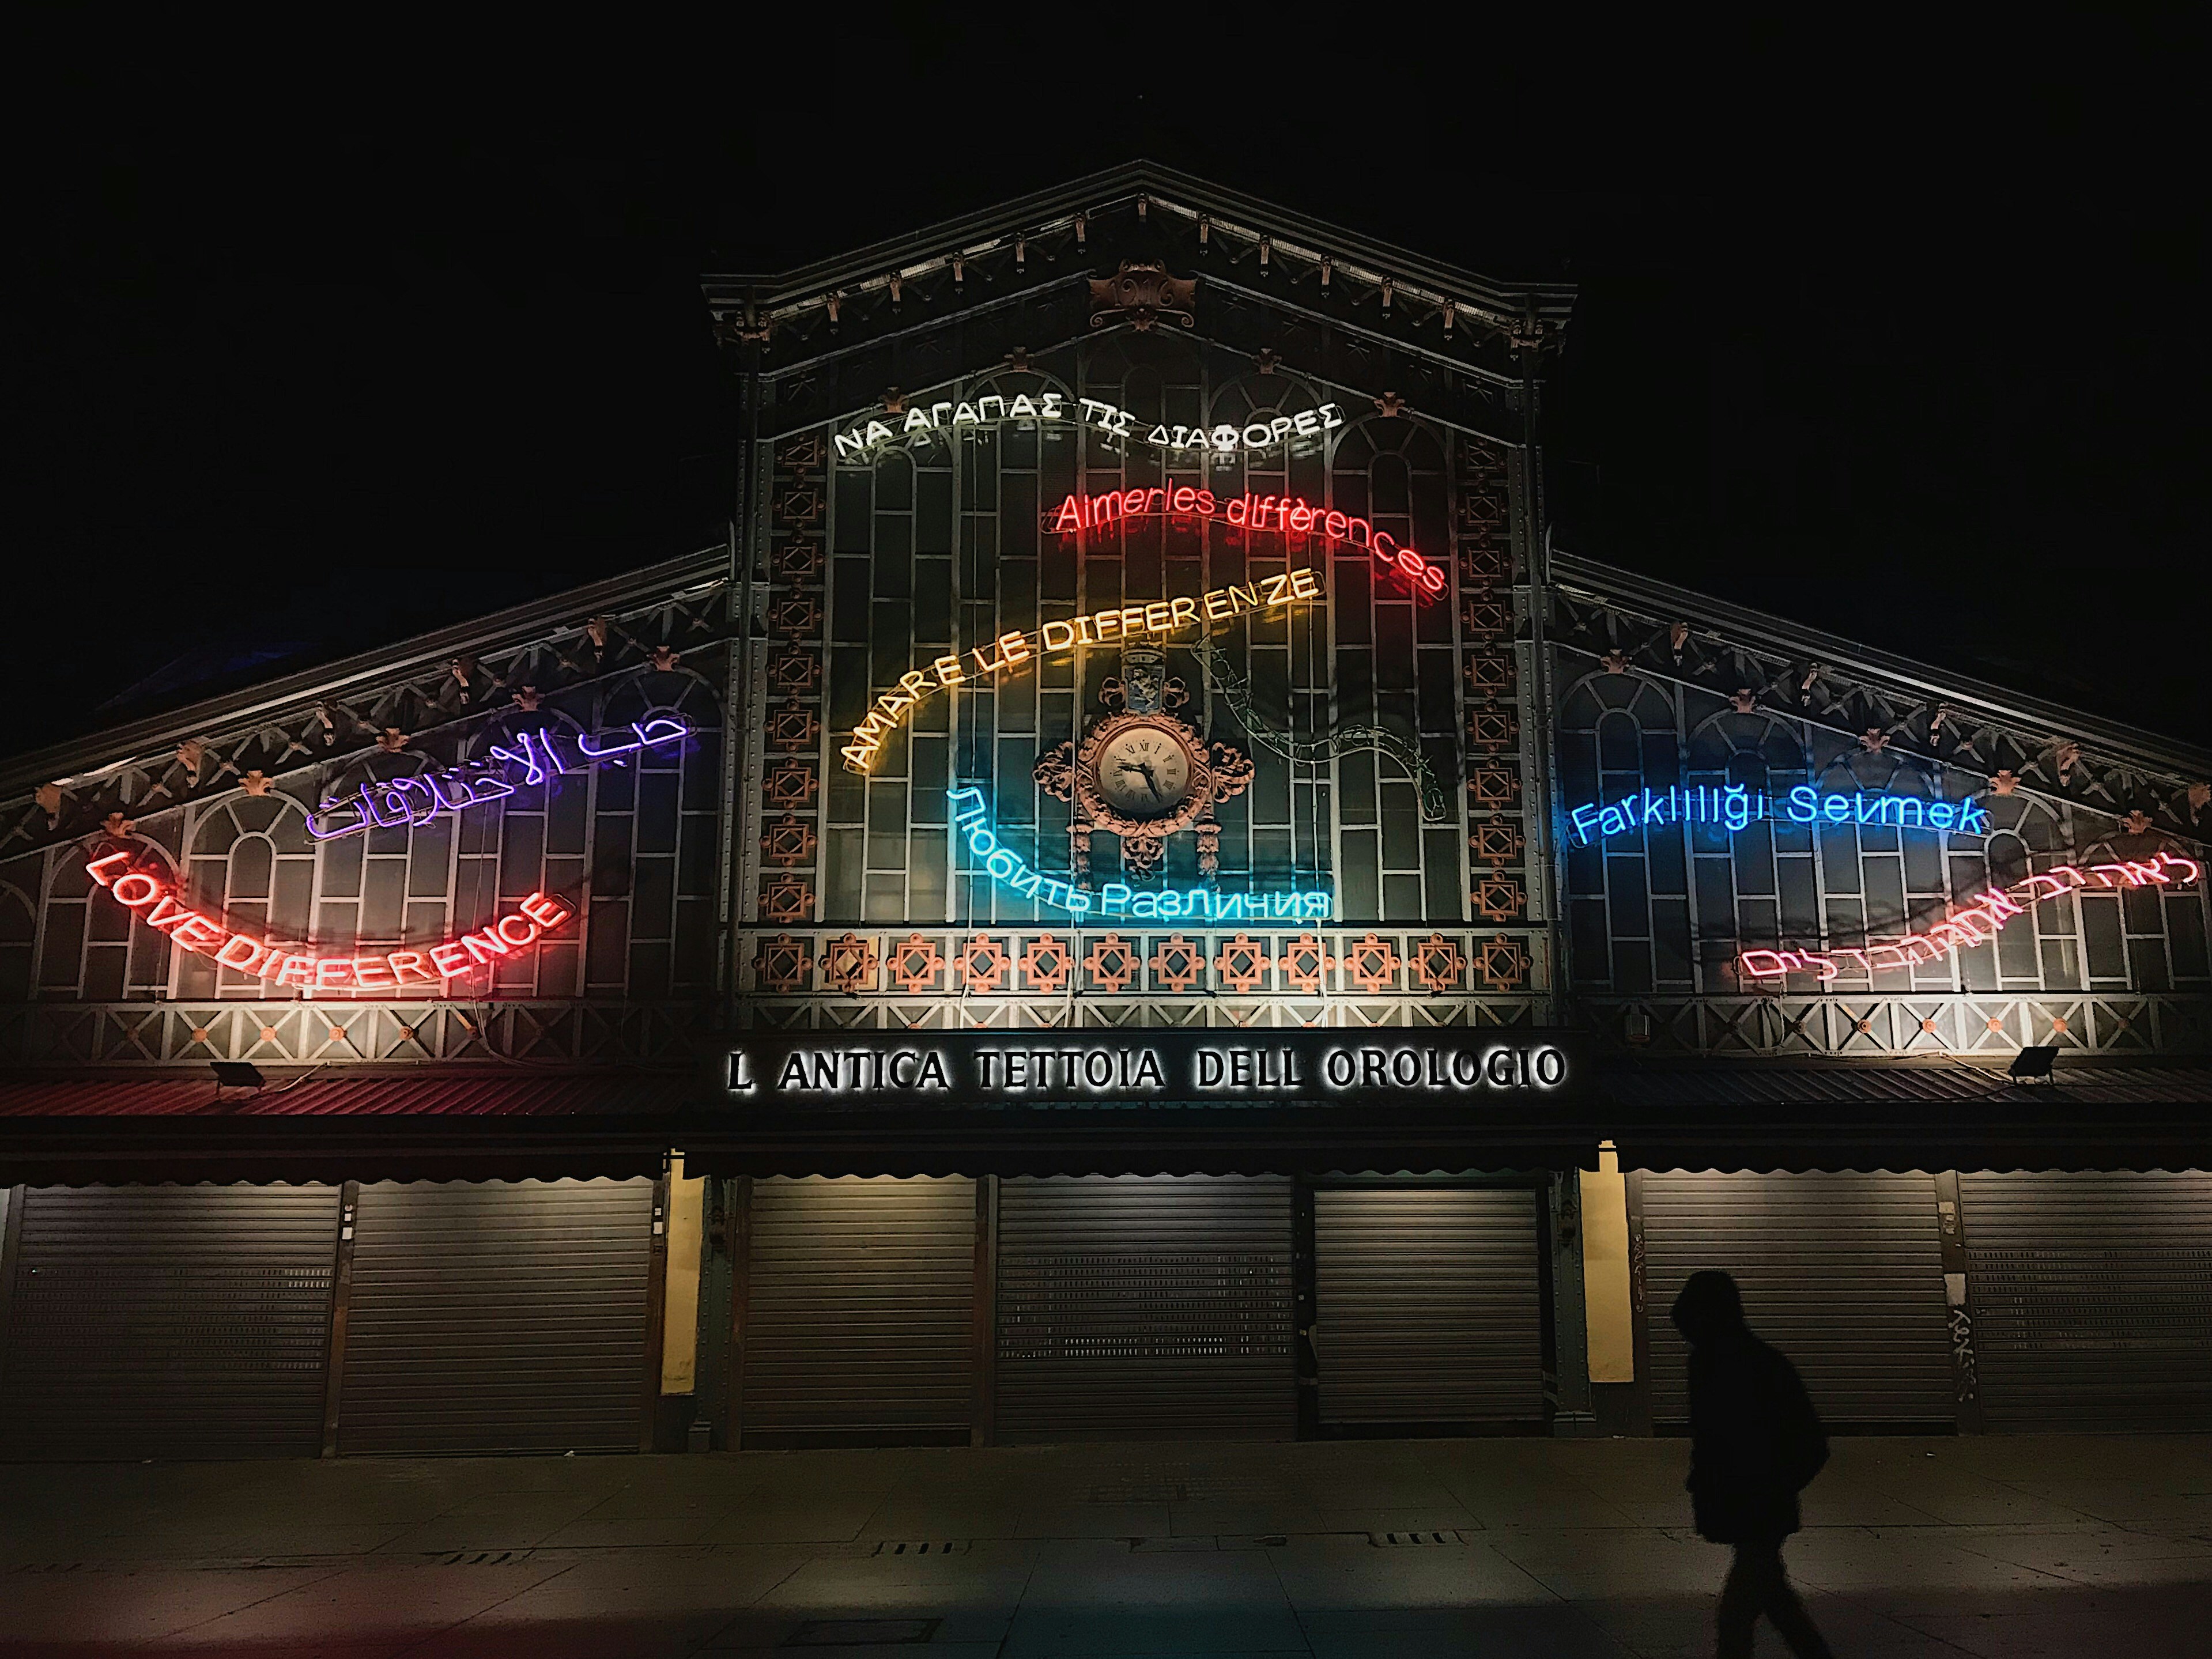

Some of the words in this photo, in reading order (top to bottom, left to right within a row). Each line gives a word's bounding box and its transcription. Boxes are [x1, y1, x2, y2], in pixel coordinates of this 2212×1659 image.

[835, 421, 892, 456] ΝΑ
[904, 394, 1062, 432] ΑΓΑΠΑΣ
[1079, 398, 1135, 437] ΤΙΣ
[1147, 403, 1342, 451] ΔΙΑΦΟΡΕΣ
[841, 655, 965, 769] AMARE
[972, 631, 1029, 672] LE
[1042, 568, 1318, 650] DIFFERENZE
[578, 719, 688, 767] حب
[1787, 786, 1985, 835] Sevmek
[946, 788, 1091, 912] Любить
[1101, 883, 1330, 919] Различия
[2020, 852, 2198, 899] לאהוב
[86, 852, 221, 952] LOVE
[214, 891, 568, 990] DIFFERENCE
[728, 1050, 754, 1090] L
[778, 1051, 950, 1090] ANTICA
[974, 1049, 1165, 1089] TETTOIA
[1197, 1048, 1305, 1087] DELL
[1327, 1049, 1565, 1087] OROLOGIO
